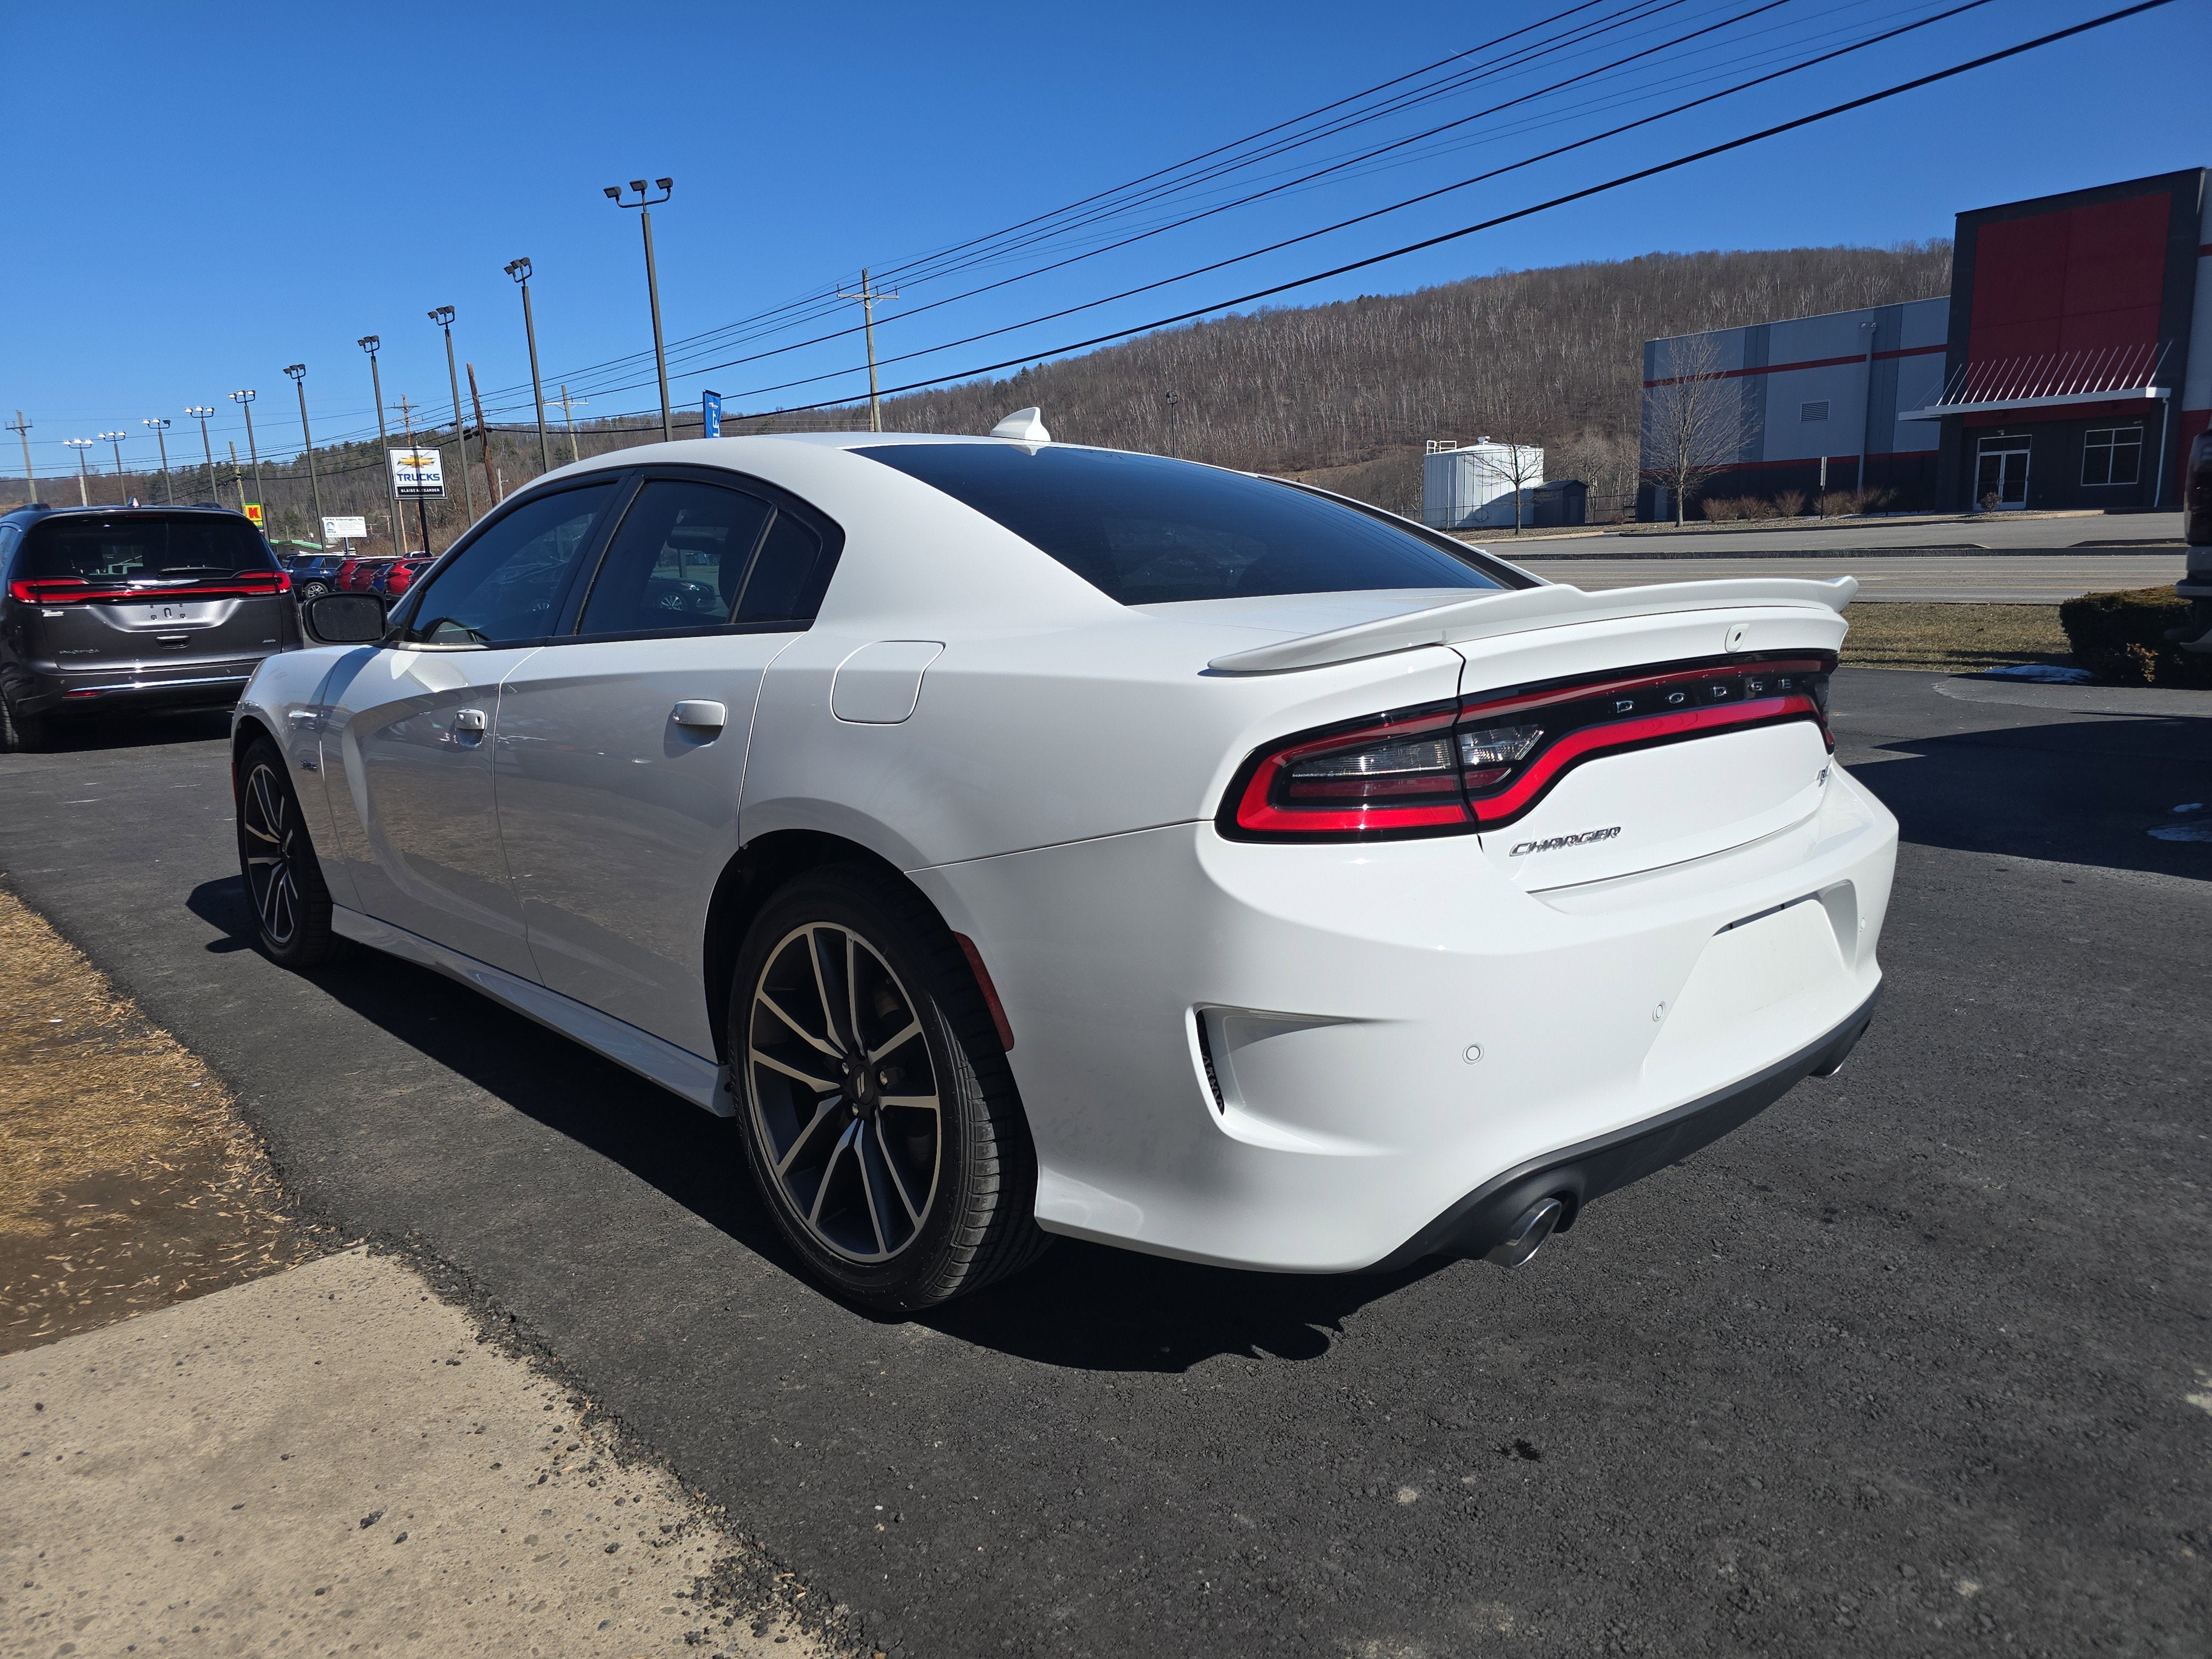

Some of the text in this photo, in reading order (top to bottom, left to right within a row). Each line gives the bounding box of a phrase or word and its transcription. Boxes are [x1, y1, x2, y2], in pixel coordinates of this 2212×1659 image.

[396, 473, 440, 481] TRUCKS
[248, 507, 261, 519] K
[1616, 678, 1792, 713] DODGE
[1509, 826, 1622, 857] CHARGER
